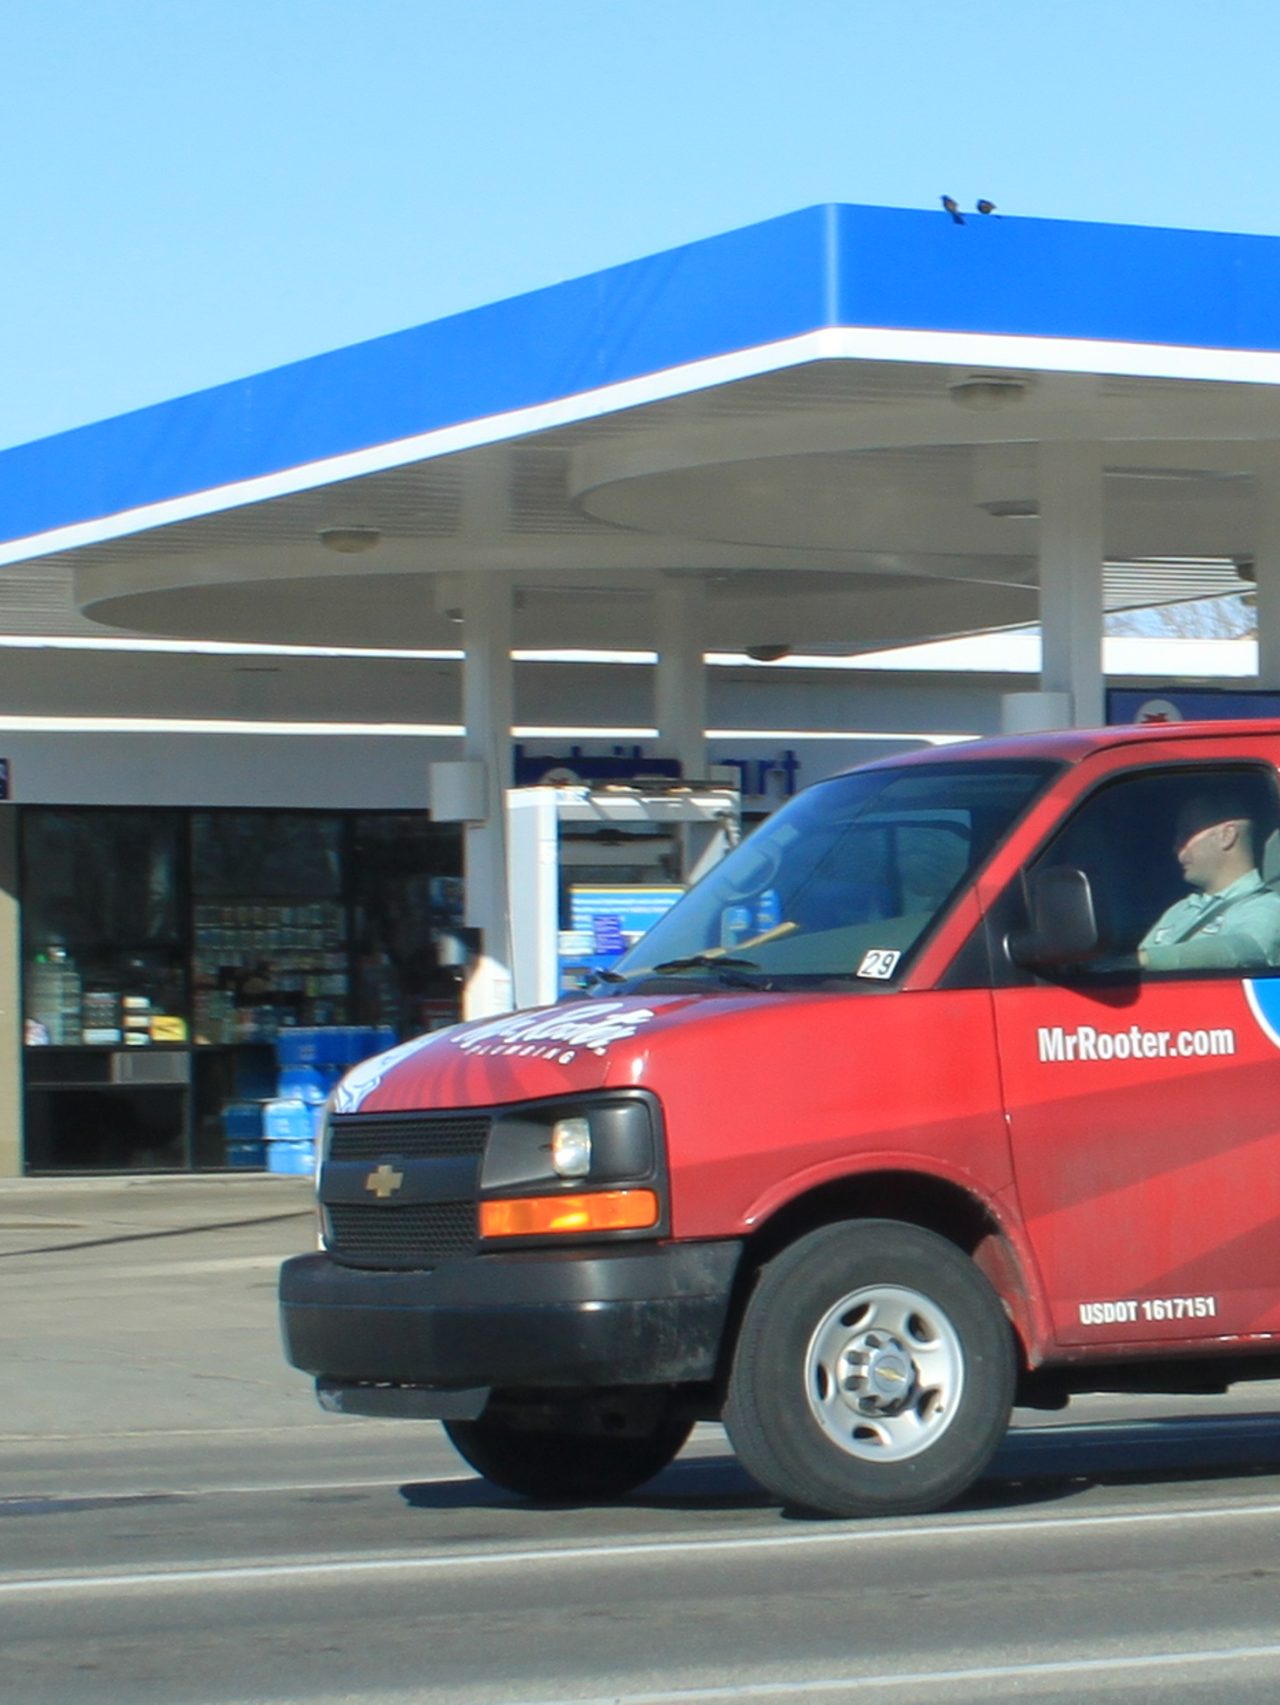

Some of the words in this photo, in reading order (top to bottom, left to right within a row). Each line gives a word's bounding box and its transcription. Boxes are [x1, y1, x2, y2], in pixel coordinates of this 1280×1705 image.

[860, 952, 896, 976] 29
[1036, 1025, 1236, 1063] MrRooter.com
[1079, 1300, 1138, 1325] USDOT
[1142, 1296, 1216, 1321] 1617151
